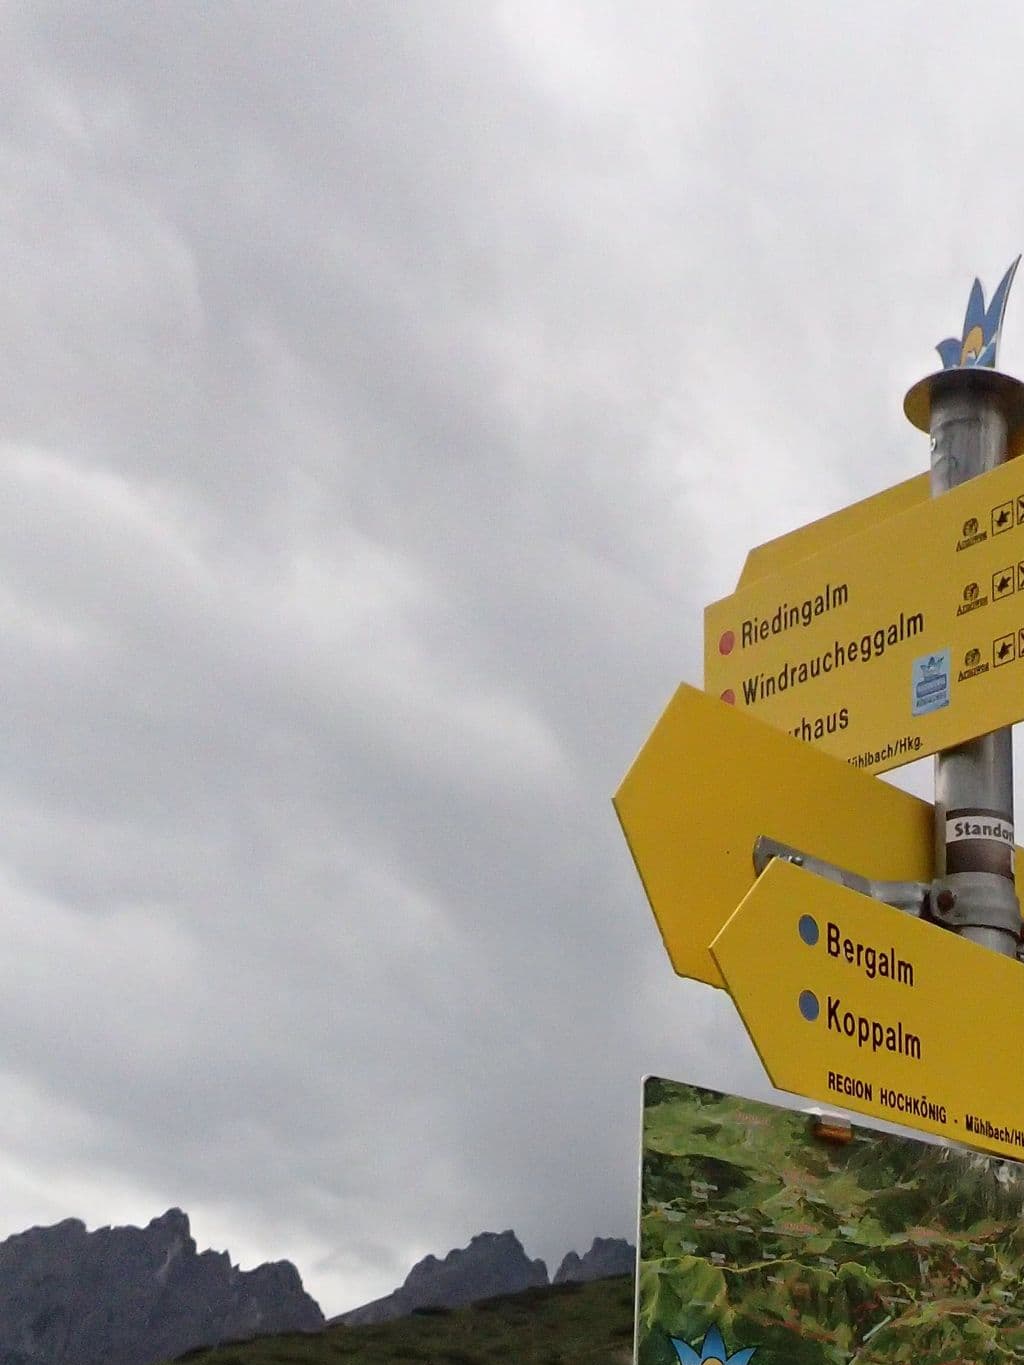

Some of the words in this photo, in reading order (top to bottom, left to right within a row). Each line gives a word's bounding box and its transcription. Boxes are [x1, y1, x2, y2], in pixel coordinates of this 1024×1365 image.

[741, 583, 848, 648] Riedingalm
[742, 612, 924, 706] Windraucheggalm
[848, 735, 924, 769] ühlbach/Hkg.
[954, 821, 1014, 841] Standor
[827, 922, 914, 987] Bergalm
[827, 996, 921, 1060] Koppalm
[828, 1071, 873, 1101] REGION
[880, 1095, 947, 1124] HOCHKÖNIG
